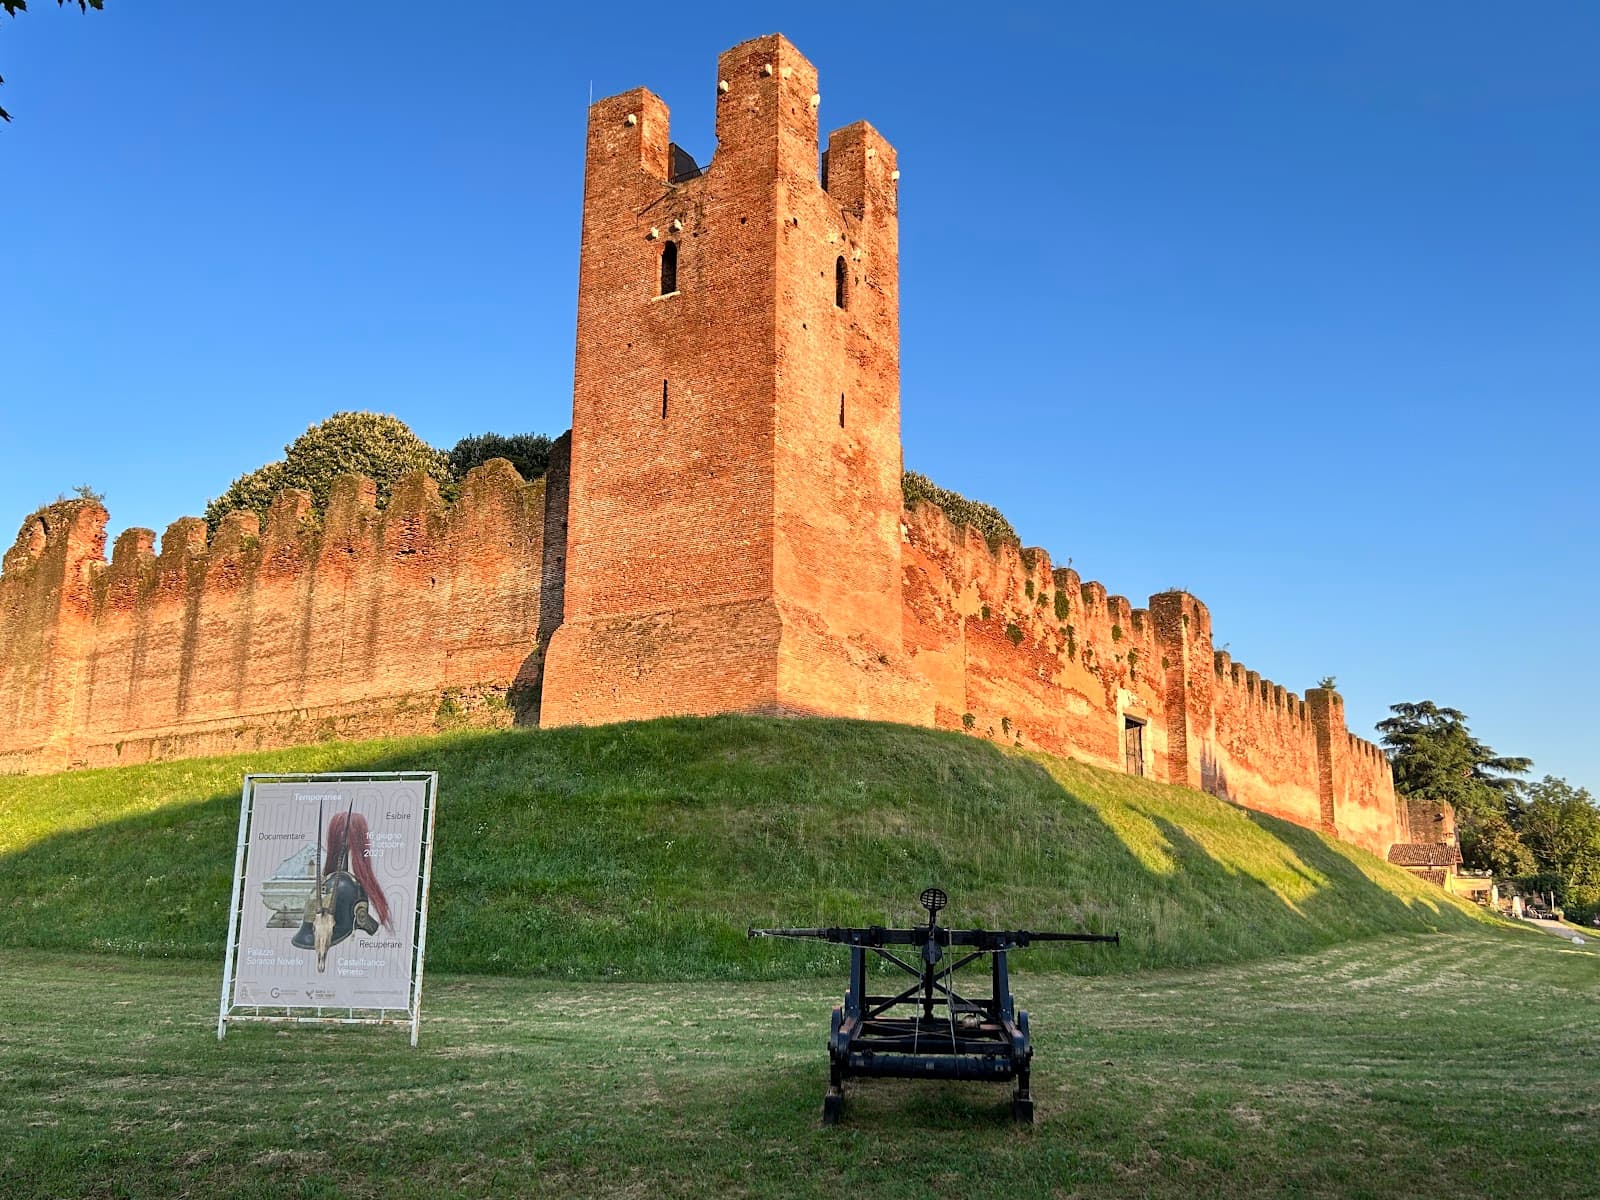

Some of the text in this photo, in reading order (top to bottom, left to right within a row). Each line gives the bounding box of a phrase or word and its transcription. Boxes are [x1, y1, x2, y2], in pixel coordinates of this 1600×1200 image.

[385, 811, 411, 820] Esibire
[258, 832, 306, 841] Documentare
[366, 831, 402, 841] 16 giugno
[376, 840, 406, 849] ottobre
[363, 848, 384, 858] 2023
[359, 939, 403, 951] Recuperare
[337, 957, 385, 967] Castelfranco
[337, 967, 363, 976] Veneto
